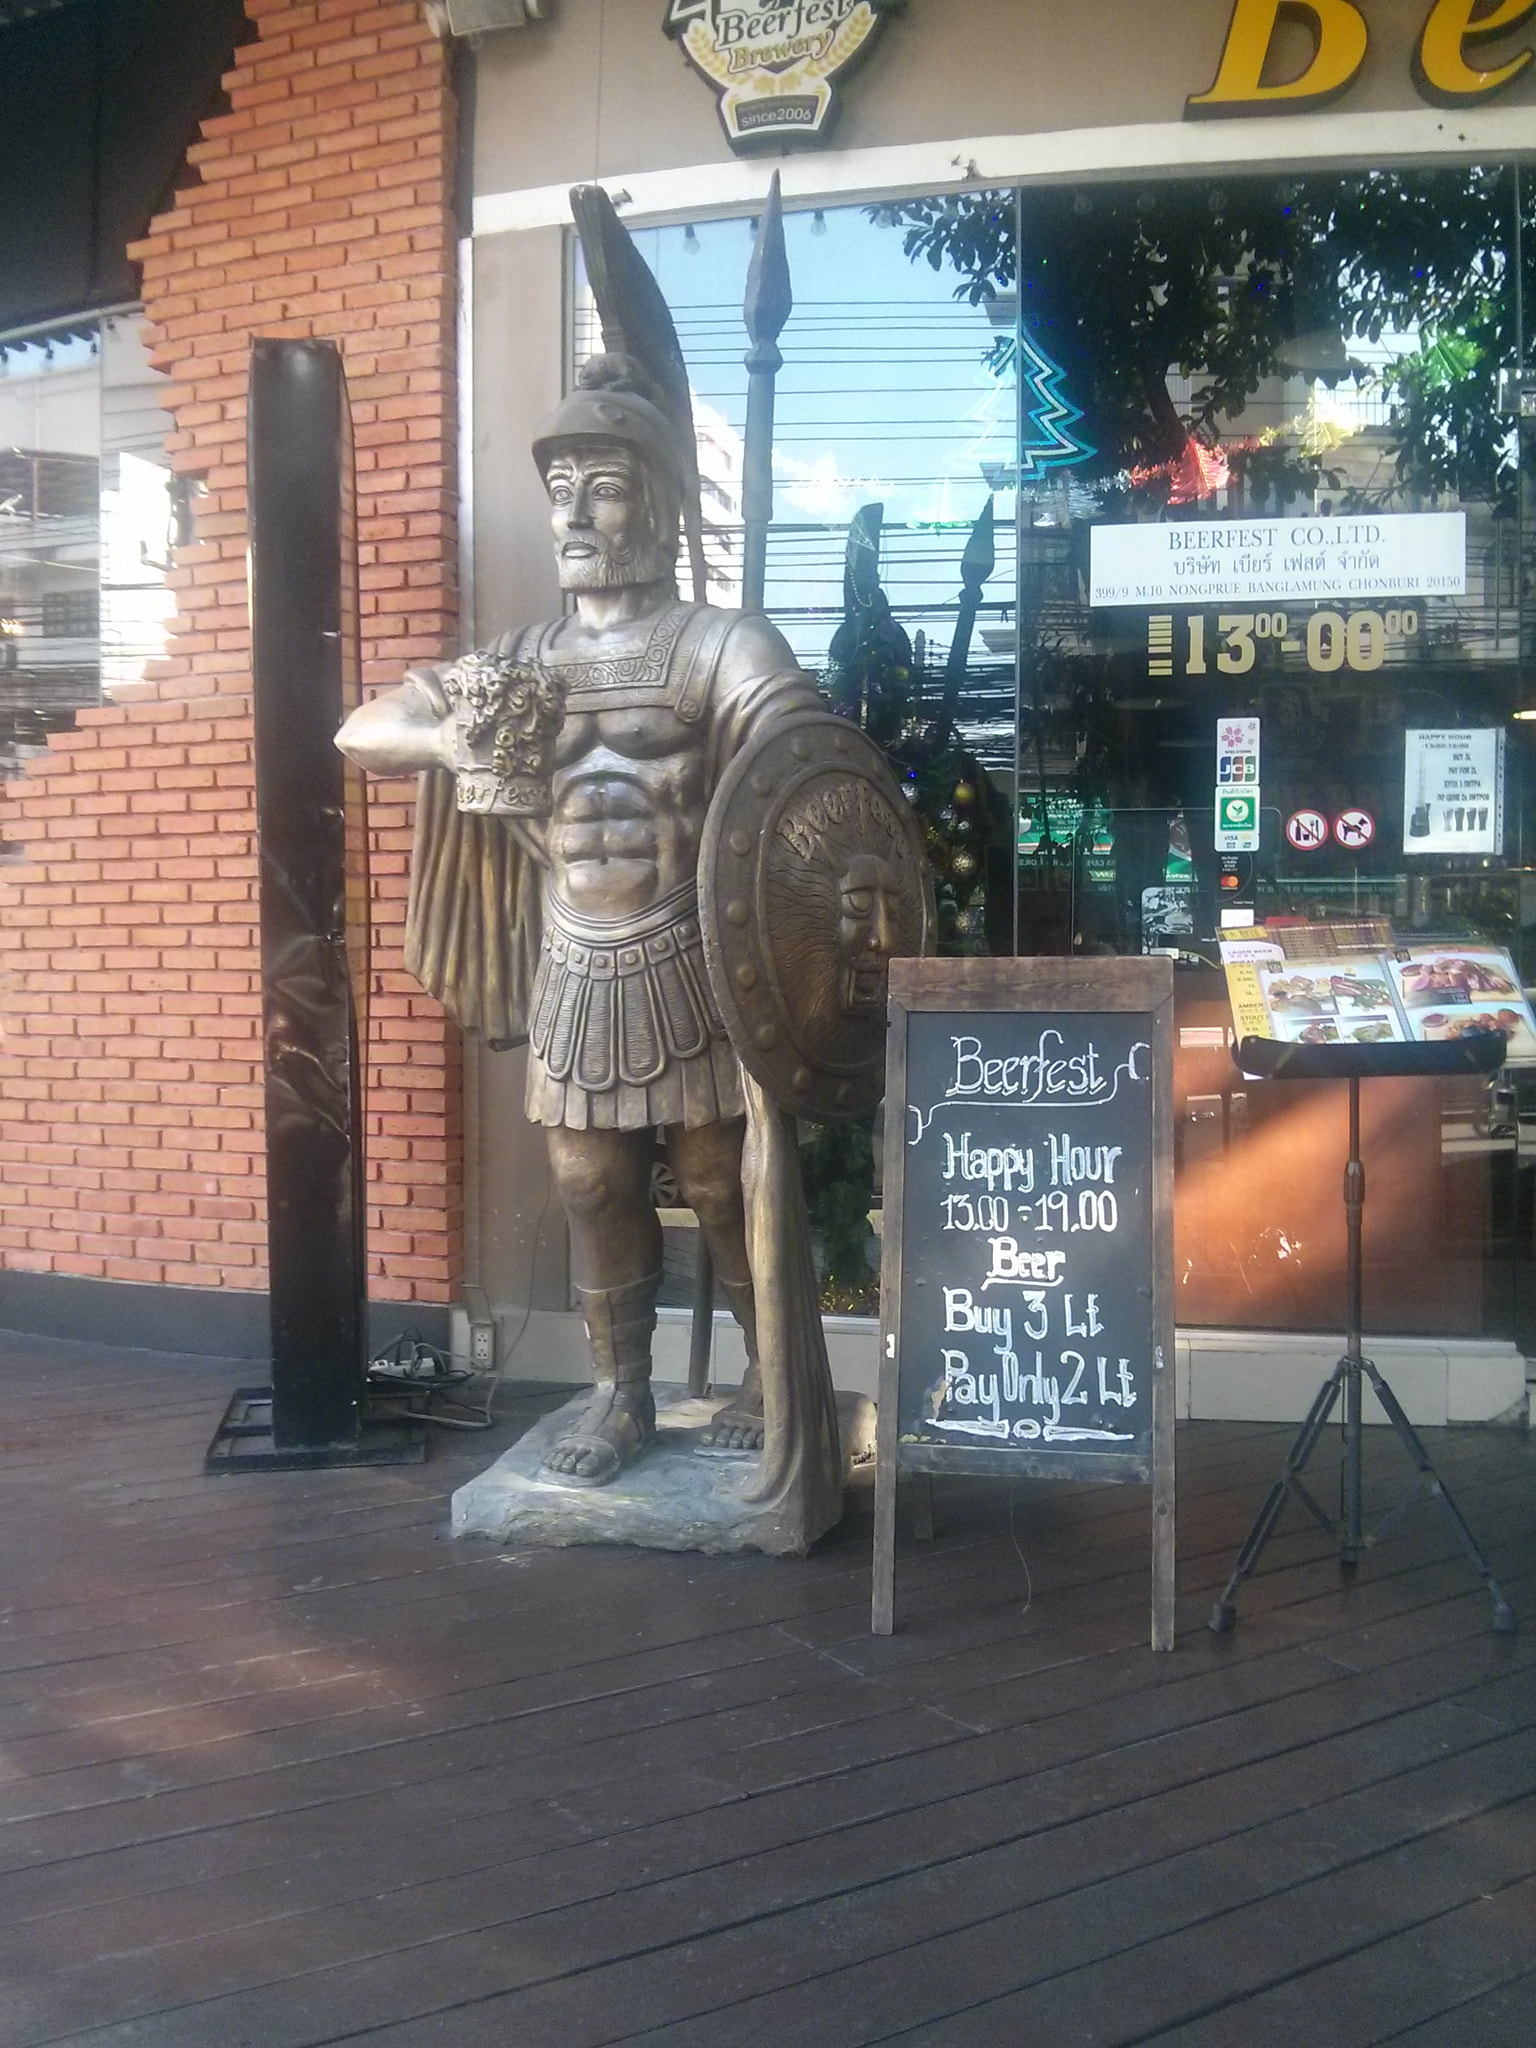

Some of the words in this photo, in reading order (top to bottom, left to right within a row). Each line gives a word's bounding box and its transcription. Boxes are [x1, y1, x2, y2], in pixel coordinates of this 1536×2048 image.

[734, 32, 829, 69] Brewery
[1168, 528, 1278, 550] BEERFEST
[1173, 555, 1221, 576] บริษัท
[1233, 552, 1273, 574] เบียร์
[1284, 550, 1327, 572] เฟสต์
[1338, 549, 1380, 570] จำกัด
[1169, 583, 1241, 596] NONGPRUE
[1248, 579, 1341, 594] BANGLAMUNG
[1349, 577, 1420, 591] CHONBURI
[945, 1029, 1107, 1103] Beerfest
[942, 1132, 1034, 1192] Happy
[1046, 1133, 1122, 1186] Hour
[940, 1193, 1009, 1231] 13.00
[1034, 1190, 1118, 1232] 19.00
[987, 1236, 1066, 1280] Beer
[942, 1286, 1014, 1354] Buy
[1022, 1290, 1048, 1340] 3
[1063, 1293, 1105, 1337] Lt
[940, 1348, 1001, 1425] Pay
[1000, 1350, 1060, 1425] Only
[1060, 1350, 1089, 1405] 2
[1096, 1356, 1138, 1407] Lt
